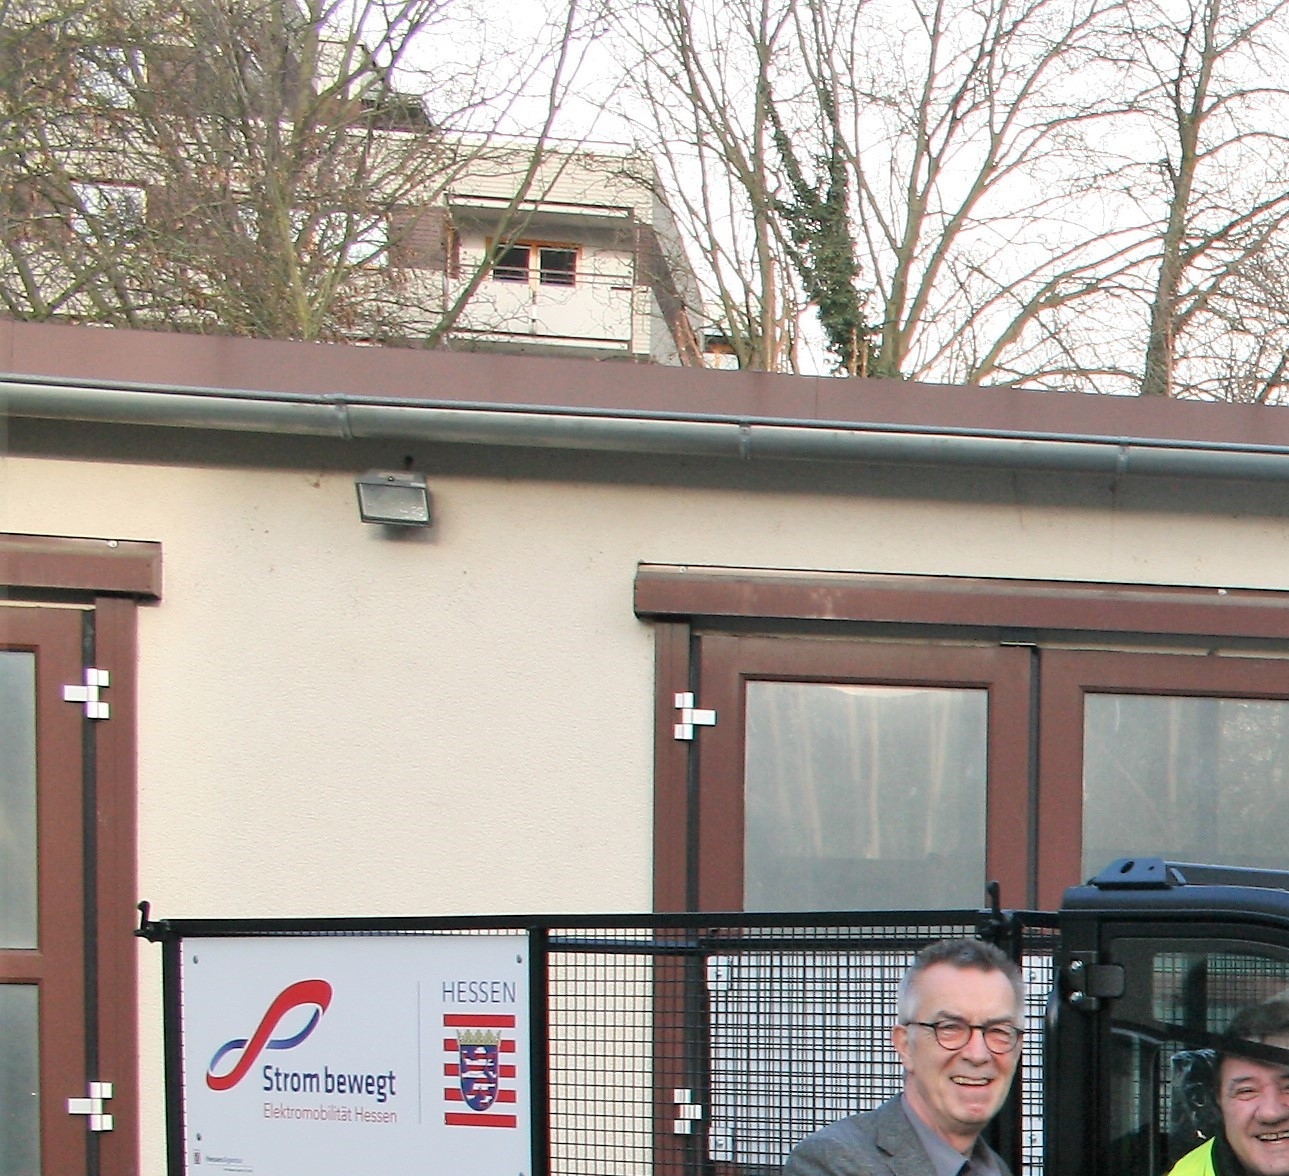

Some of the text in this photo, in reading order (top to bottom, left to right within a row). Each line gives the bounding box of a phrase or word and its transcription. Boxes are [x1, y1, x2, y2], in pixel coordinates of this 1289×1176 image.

[443, 980, 516, 1004] HESSEN
[263, 1065, 396, 1102] Strom bewegt
[263, 1103, 397, 1123] Elektromobilität Hessen
